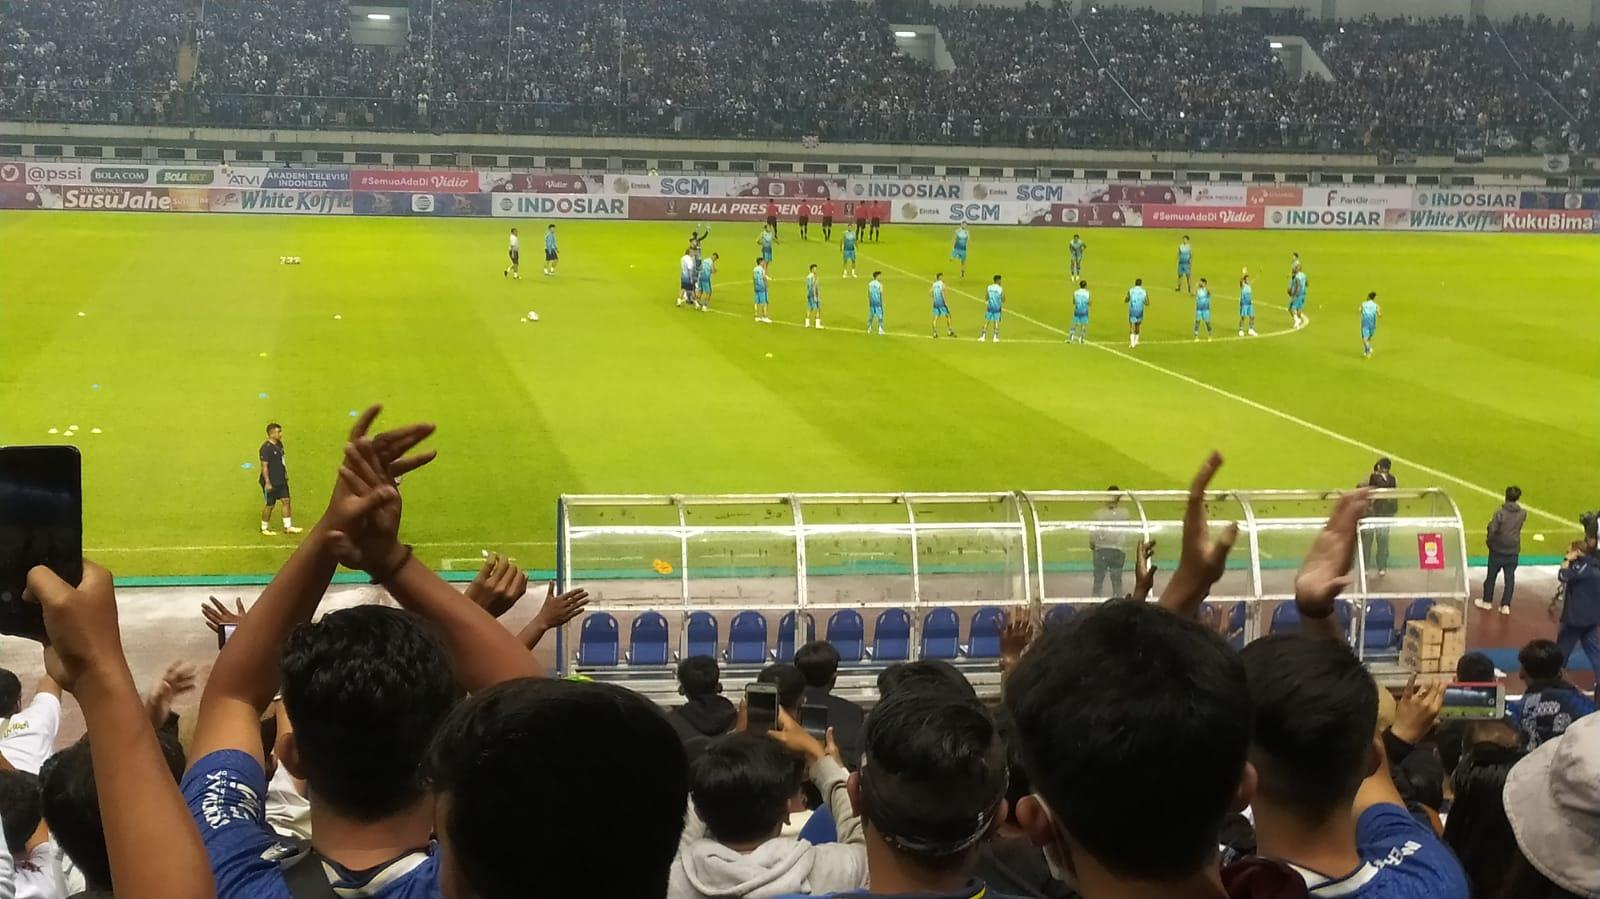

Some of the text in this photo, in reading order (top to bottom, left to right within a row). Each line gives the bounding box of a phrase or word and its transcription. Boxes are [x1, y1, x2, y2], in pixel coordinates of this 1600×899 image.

[28, 166, 82, 182] @pssi
[228, 175, 260, 185] ATVI
[267, 171, 348, 182] AKADEMI TELEVISI
[361, 175, 469, 189] #SemuaAdaDi Vidio
[279, 180, 328, 188] INDONESIA
[660, 177, 709, 196] SCM
[868, 183, 961, 199] INDOSIAR
[64, 190, 171, 210] SusuJahe
[240, 190, 294, 210] White
[1016, 184, 1063, 201] SCM
[1431, 192, 1517, 208] INDOSIAR
[517, 197, 625, 214] INDOSIAR
[689, 202, 727, 215] PIALA
[730, 203, 800, 215] PRESDEN
[950, 203, 1000, 221] SCM
[1153, 209, 1256, 223] #SemuaAdaDi Vidio
[1286, 209, 1381, 226] INDOSIAR
[1409, 209, 1454, 228] White
[1503, 213, 1593, 231] KukuBima
